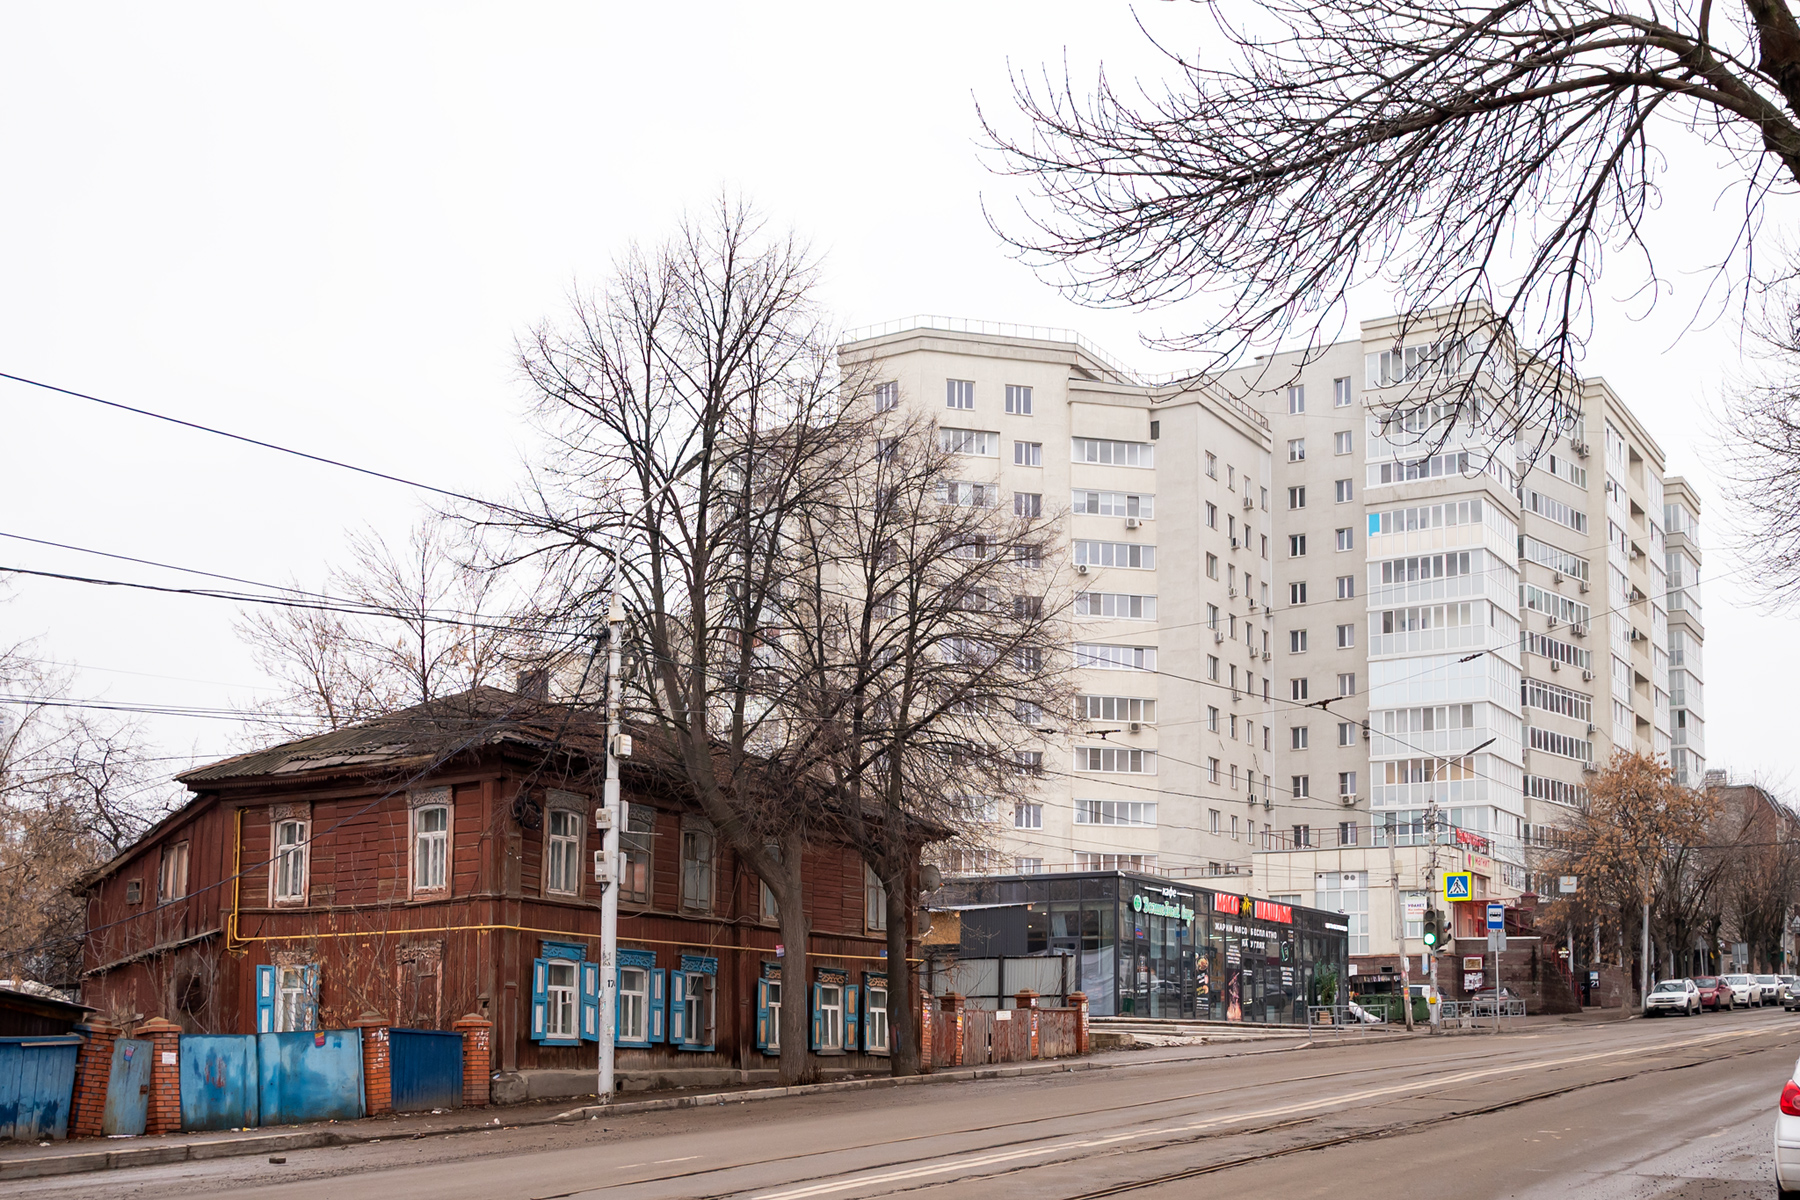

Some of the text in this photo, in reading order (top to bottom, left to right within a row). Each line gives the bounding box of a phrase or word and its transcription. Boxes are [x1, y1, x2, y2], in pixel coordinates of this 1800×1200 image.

[1214, 892, 1292, 924] МЯСО ШАШЛЫК
[1214, 922, 1233, 933] ЖАРИМ
[1234, 925, 1248, 935] МЯСО
[1250, 927, 1277, 939] БЕСПЛАТНО
[1241, 939, 1249, 948] НА
[1590, 980, 1600, 988] 21
